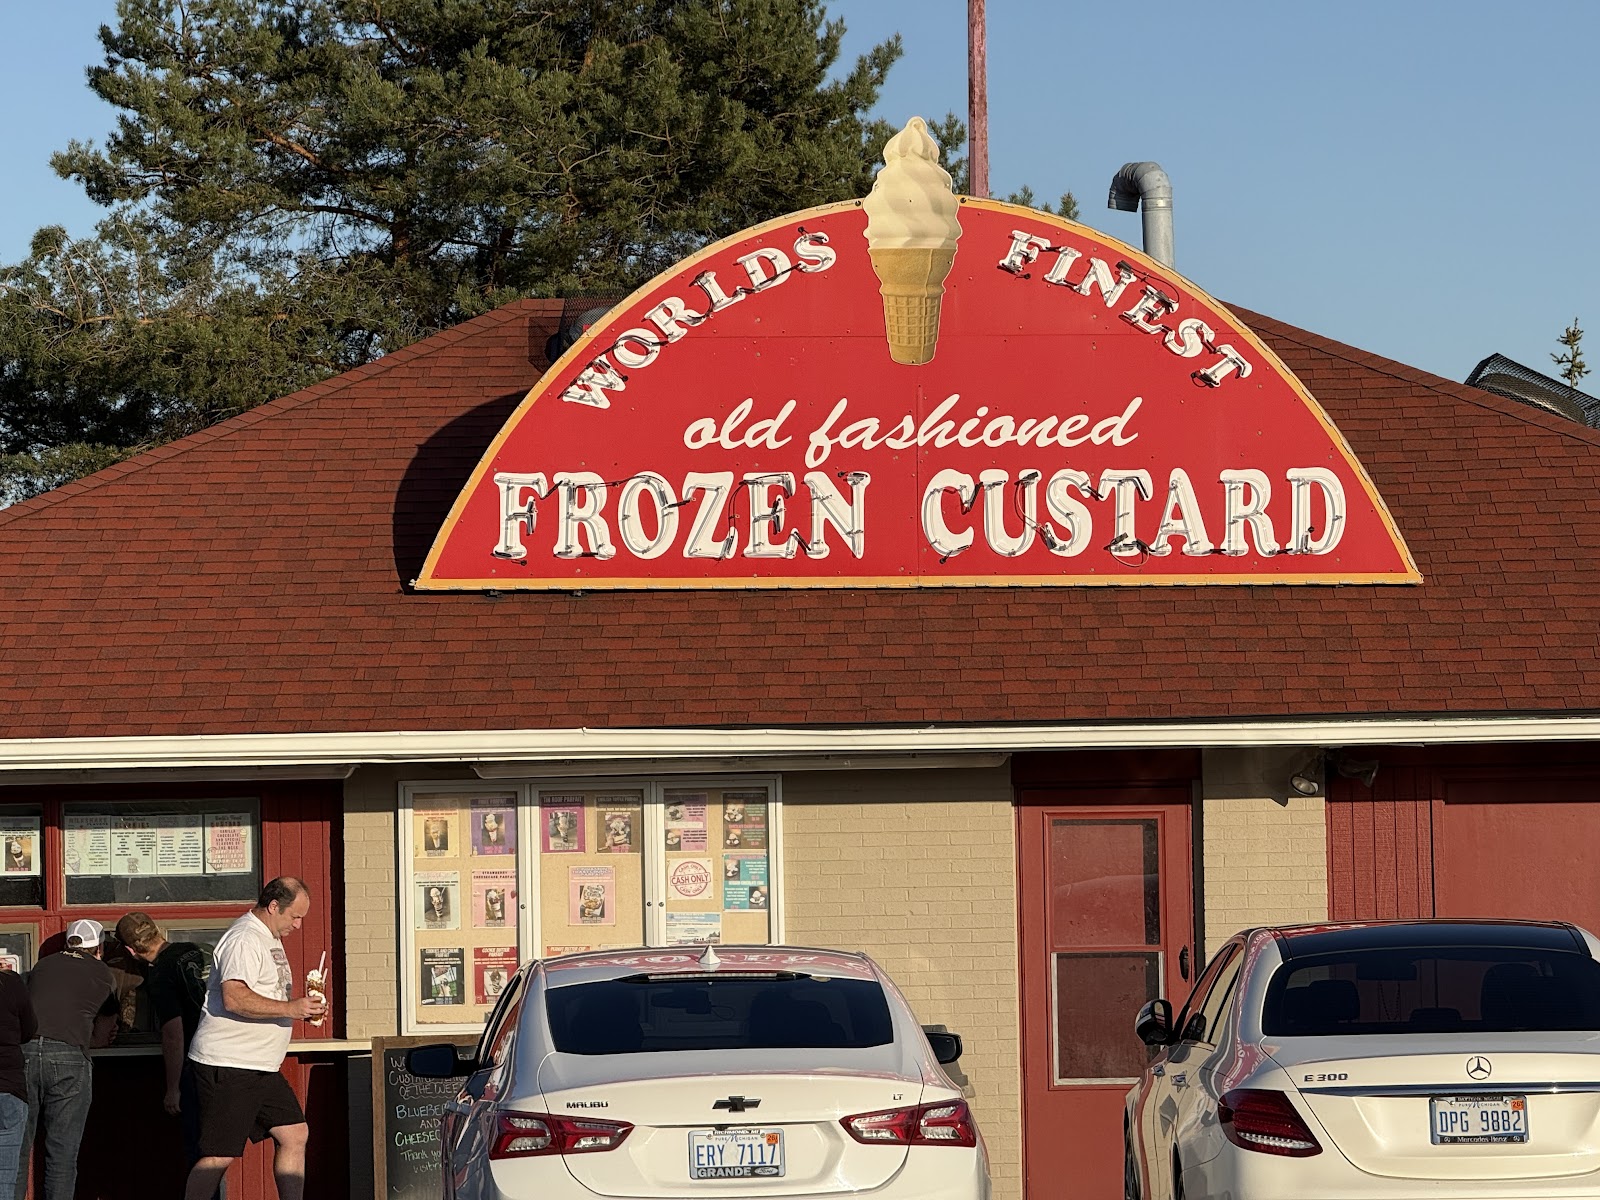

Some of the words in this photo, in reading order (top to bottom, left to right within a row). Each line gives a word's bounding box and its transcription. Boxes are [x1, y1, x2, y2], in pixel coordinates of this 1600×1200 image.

[562, 231, 837, 410] WORLDS
[998, 229, 1253, 388] FINEST
[683, 397, 797, 450] old
[804, 393, 1144, 469] fashioned
[493, 470, 872, 561] FROZEN
[920, 466, 1347, 558] CUSTARD
[671, 876, 690, 885] CASH
[690, 874, 709, 883] ONLY
[1304, 1074, 1314, 1082] E
[1316, 1073, 1348, 1082] 300
[412, 1084, 433, 1095] THE
[420, 1118, 442, 1129] AND
[1439, 1111, 1469, 1133] DPG
[1480, 1110, 1522, 1132] 9882
[395, 1130, 441, 1146] CHEESEC
[727, 1134, 758, 1143] MICHIGAN
[400, 1149, 429, 1161] Thank
[431, 1150, 442, 1161] yo
[696, 1145, 725, 1166] ERY
[737, 1143, 776, 1165] 7117
[697, 1167, 752, 1178] GRANDE
